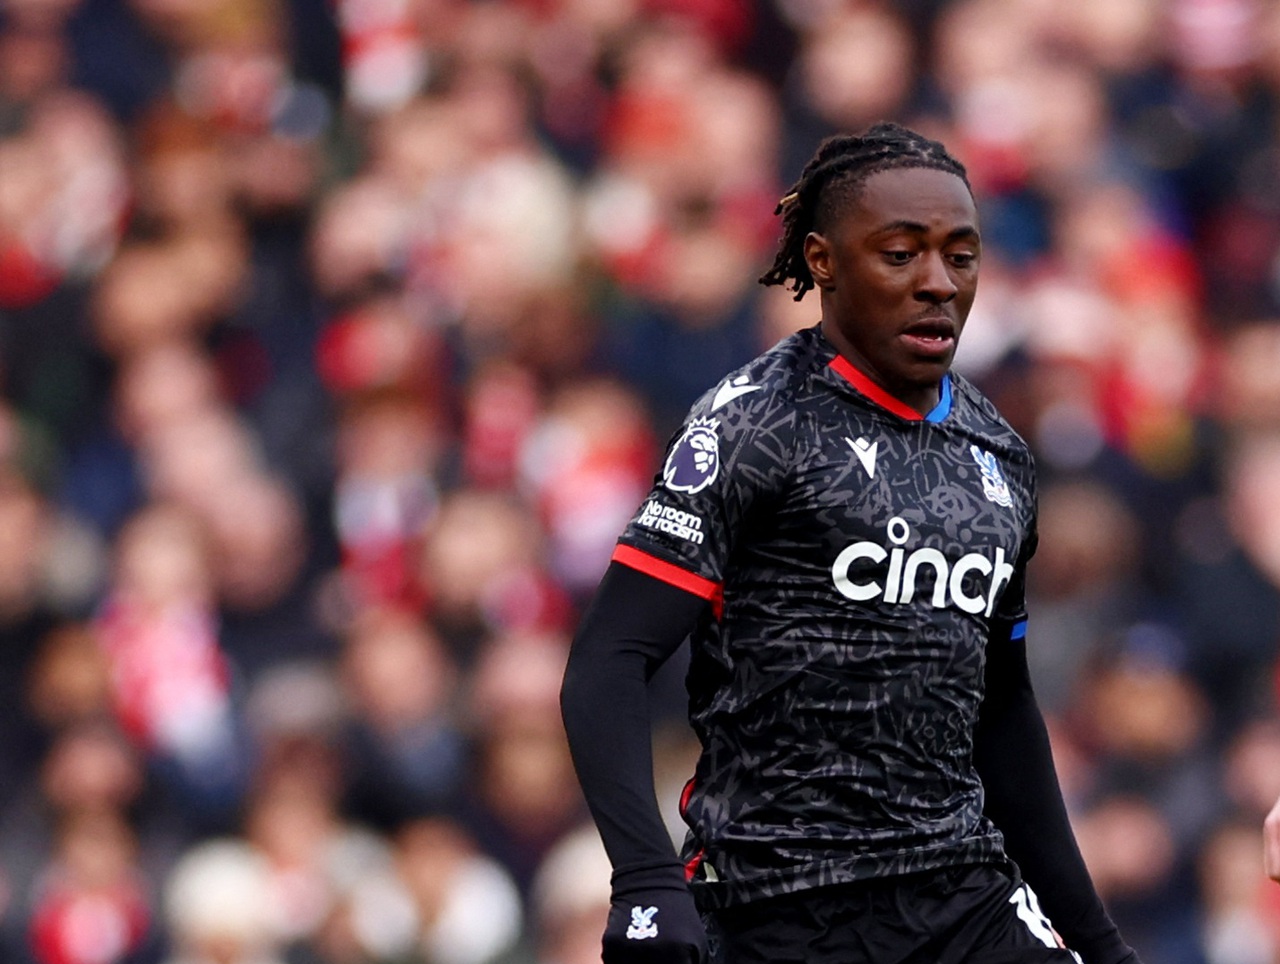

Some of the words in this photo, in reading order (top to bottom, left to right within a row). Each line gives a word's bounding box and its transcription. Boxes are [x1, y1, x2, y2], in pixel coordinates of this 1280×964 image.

[643, 500, 663, 516] No
[661, 505, 702, 530] room
[654, 517, 704, 544] racism
